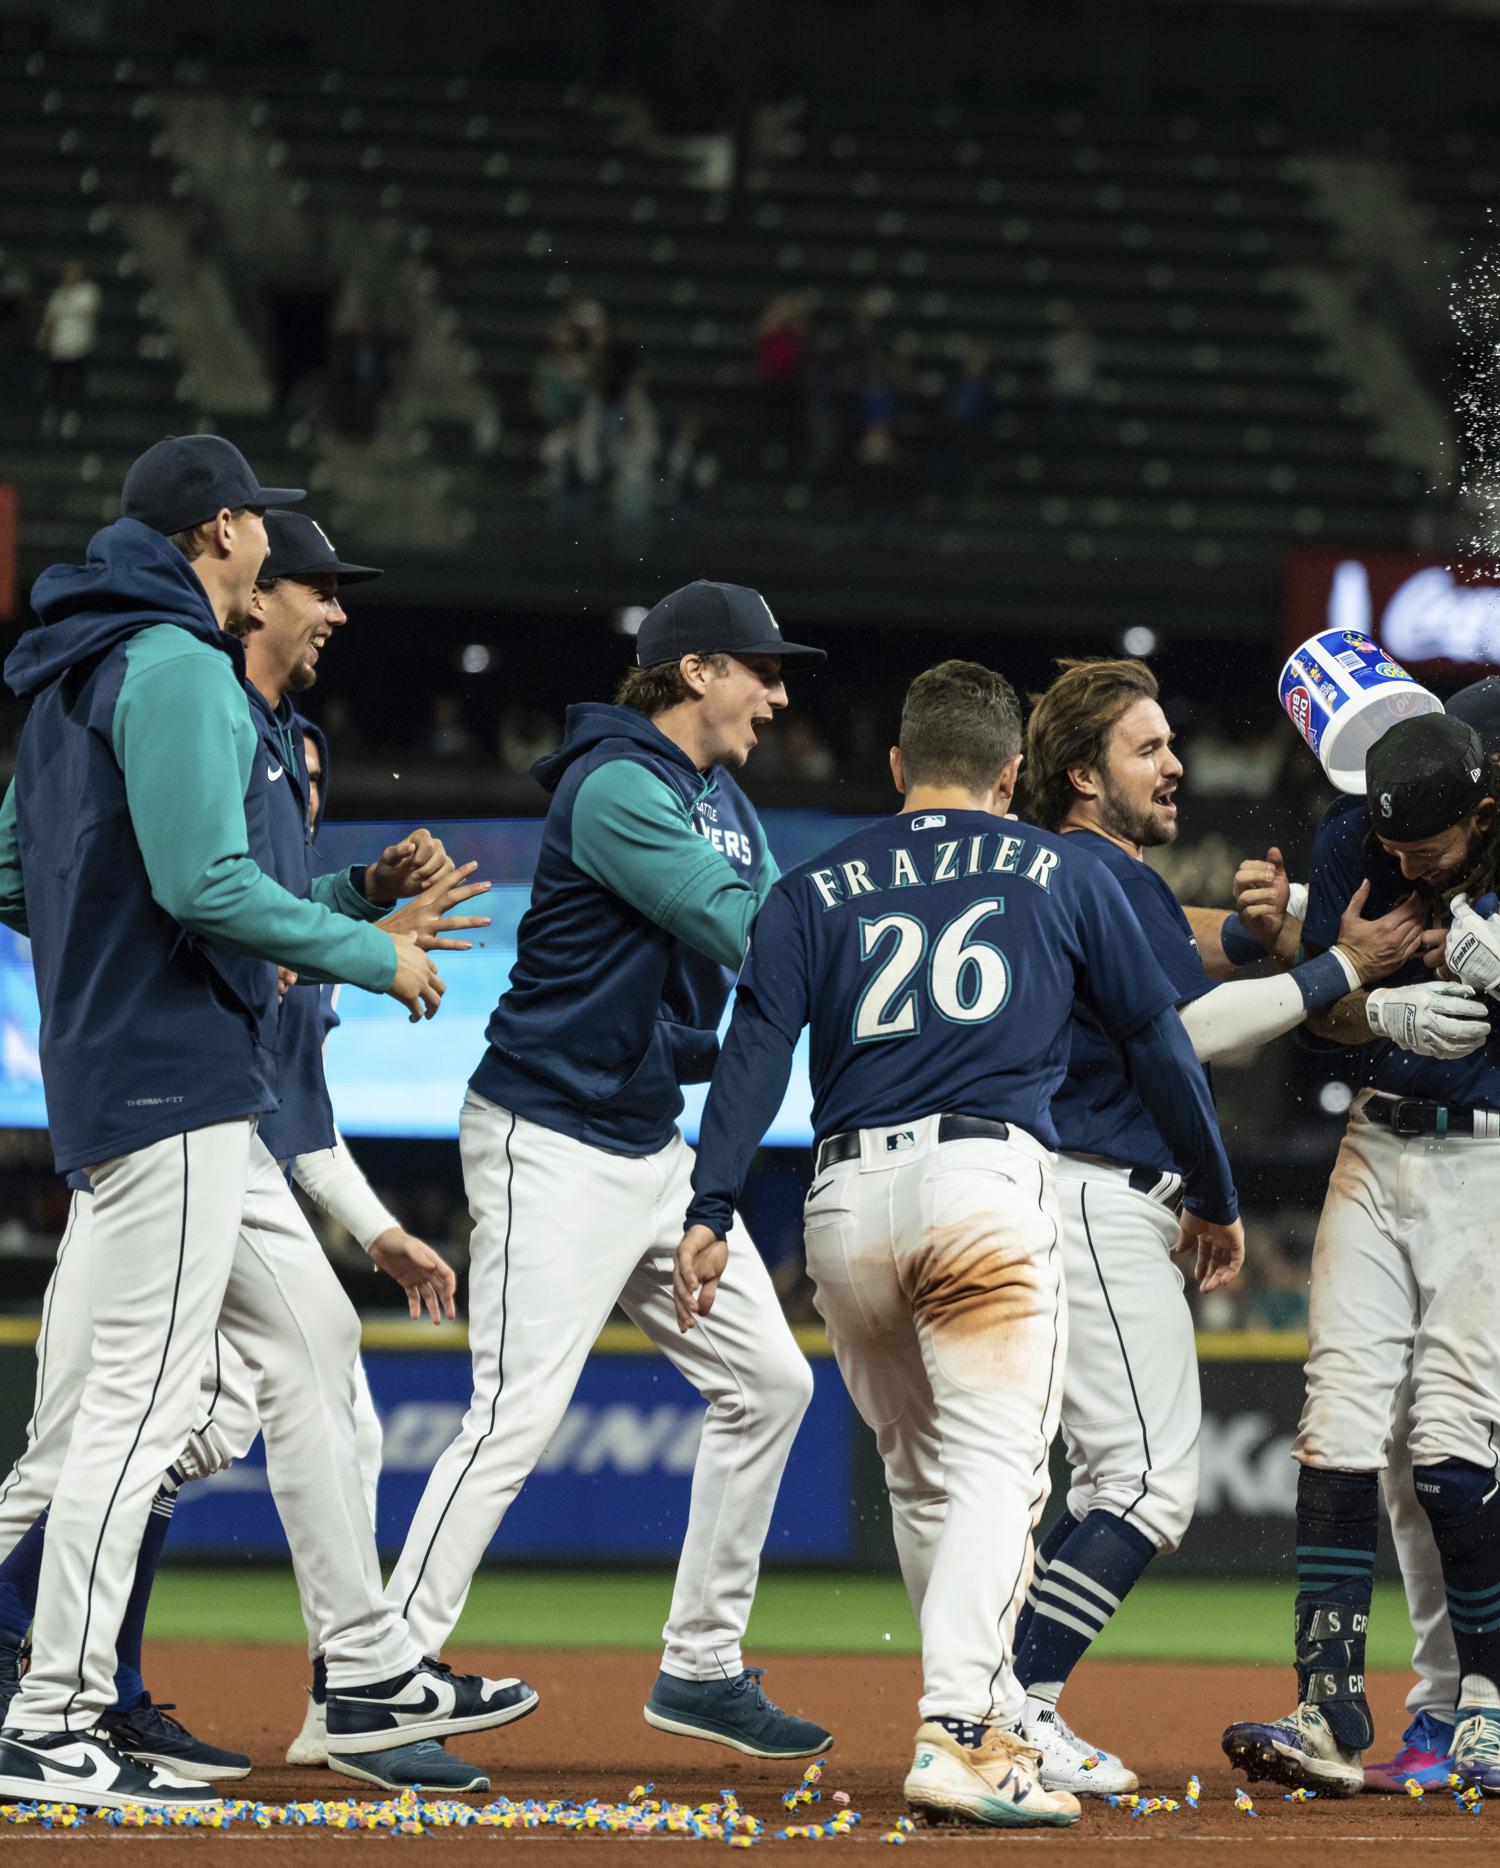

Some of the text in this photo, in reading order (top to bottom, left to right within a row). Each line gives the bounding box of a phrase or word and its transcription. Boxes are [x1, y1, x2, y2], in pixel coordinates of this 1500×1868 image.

[1380, 793, 1393, 818] S
[804, 832, 1061, 913] FRAZIER
[852, 896, 1012, 1045] 26
[1451, 936, 1477, 970] Franklin
